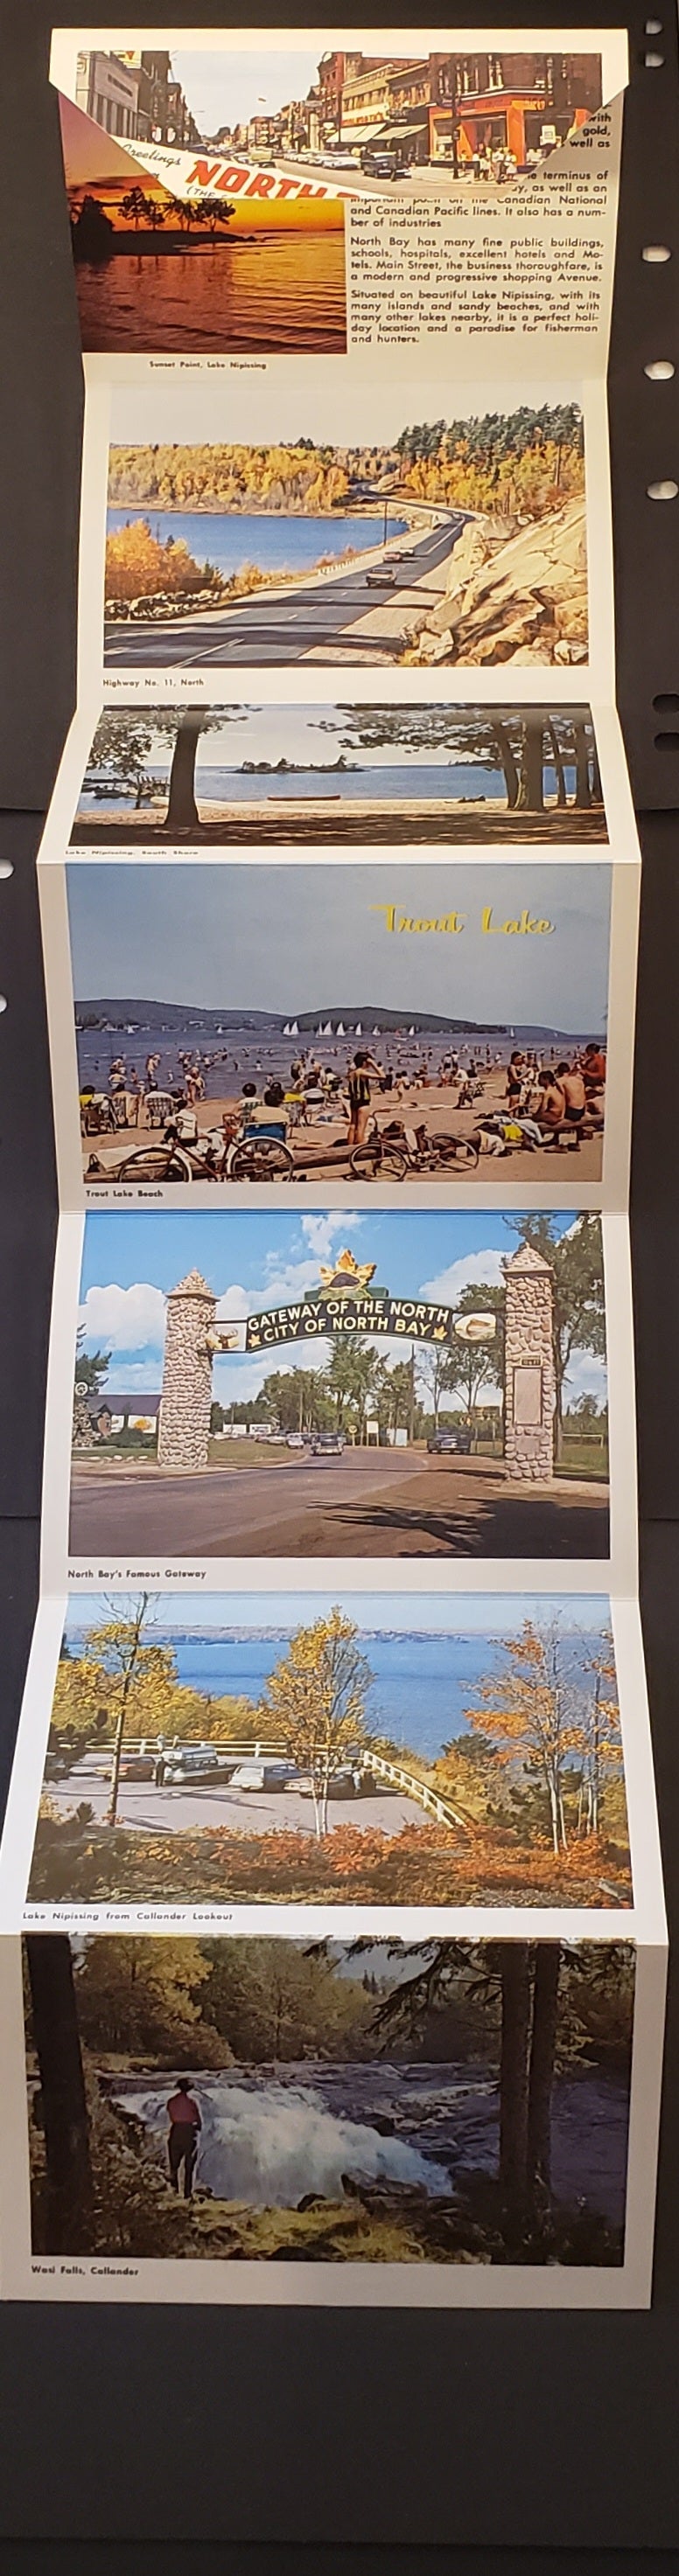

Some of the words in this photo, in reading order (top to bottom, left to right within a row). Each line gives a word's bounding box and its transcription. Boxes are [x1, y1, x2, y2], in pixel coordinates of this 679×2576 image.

[583, 125, 611, 136] gold,
[570, 138, 592, 148] well
[543, 171, 591, 180] terminus
[597, 171, 608, 180] of
[549, 183, 572, 191] well
[559, 196, 607, 205] National
[351, 205, 371, 215] and
[375, 205, 430, 215] Canadian
[434, 206, 469, 216] Pacific
[472, 206, 500, 216] lines.
[506, 206, 513, 216] It
[517, 206, 539, 216] also
[543, 207, 562, 216] has
[351, 218, 369, 227] ber
[373, 218, 384, 227] of
[389, 218, 441, 227] industries
[351, 237, 381, 247] North
[389, 237, 410, 248] Bay
[417, 237, 437, 247] has
[444, 240, 475, 249] many
[483, 237, 502, 247] fine
[510, 238, 543, 249] public
[550, 238, 604, 250] buildings,
[351, 248, 392, 259] schools,
[401, 248, 452, 260] hospitals,
[459, 249, 507, 259] excellent
[514, 249, 546, 259] hotels
[554, 249, 575, 259] and
[583, 250, 604, 259] Mo-
[351, 260, 372, 269] tels.
[376, 261, 403, 269] Main
[408, 261, 442, 271] Street,
[446, 261, 463, 270] the
[467, 261, 512, 270] business
[516, 261, 590, 272] thoroughfare,
[595, 261, 603, 270] is
[363, 271, 404, 281] modern
[410, 272, 430, 282] and
[436, 272, 498, 283] progressive
[503, 272, 552, 284] shopping
[557, 273, 602, 282] Avenue.
[351, 289, 395, 299] Situated
[418, 289, 467, 300] beautiful
[472, 289, 497, 300] Lake
[502, 290, 555, 302] Nipissing,
[559, 290, 583, 300] with
[588, 290, 601, 300] its
[351, 303, 382, 313] many
[388, 301, 424, 310] islands
[431, 301, 452, 310] and
[458, 301, 491, 313] sandy
[497, 301, 542, 312] beaches,
[549, 302, 570, 310] and
[576, 302, 600, 310] with
[351, 314, 382, 324] many
[386, 312, 414, 322] other
[419, 312, 446, 322] lakes
[452, 312, 492, 324] nearby,
[497, 313, 504, 322] it
[509, 313, 517, 322] is
[534, 312, 570, 324] perfect
[575, 313, 598, 322] holi-
[351, 323, 372, 334] day
[378, 323, 420, 332] location
[427, 323, 448, 332] and
[469, 324, 515, 334] paradise
[522, 323, 538, 332] for
[545, 324, 598, 333] fisherman
[352, 333, 372, 343] and
[377, 333, 419, 343] hunters.
[230, 361, 267, 370] Nipissing
[102, 679, 140, 688] Highway
[164, 679, 177, 687] 11,
[367, 904, 468, 934] Trout
[480, 906, 556, 935] Lake
[248, 1302, 322, 1332] GATEWAY
[326, 1300, 348, 1315] OF
[354, 1300, 383, 1314] THE
[390, 1301, 450, 1323] NORTH
[263, 1322, 299, 1342] CITY
[304, 1318, 326, 1333] OF
[332, 1316, 388, 1331] NORTH
[395, 1319, 431, 1336] BAY
[67, 1570, 94, 1578] North
[98, 1570, 122, 1580] Bay's
[126, 1570, 160, 1578] Famous
[164, 1570, 206, 1579] Gateway
[52, 1912, 100, 1921] Nipissing
[60, 2266, 86, 2275] Falls,
[90, 2266, 139, 2275] Callander
